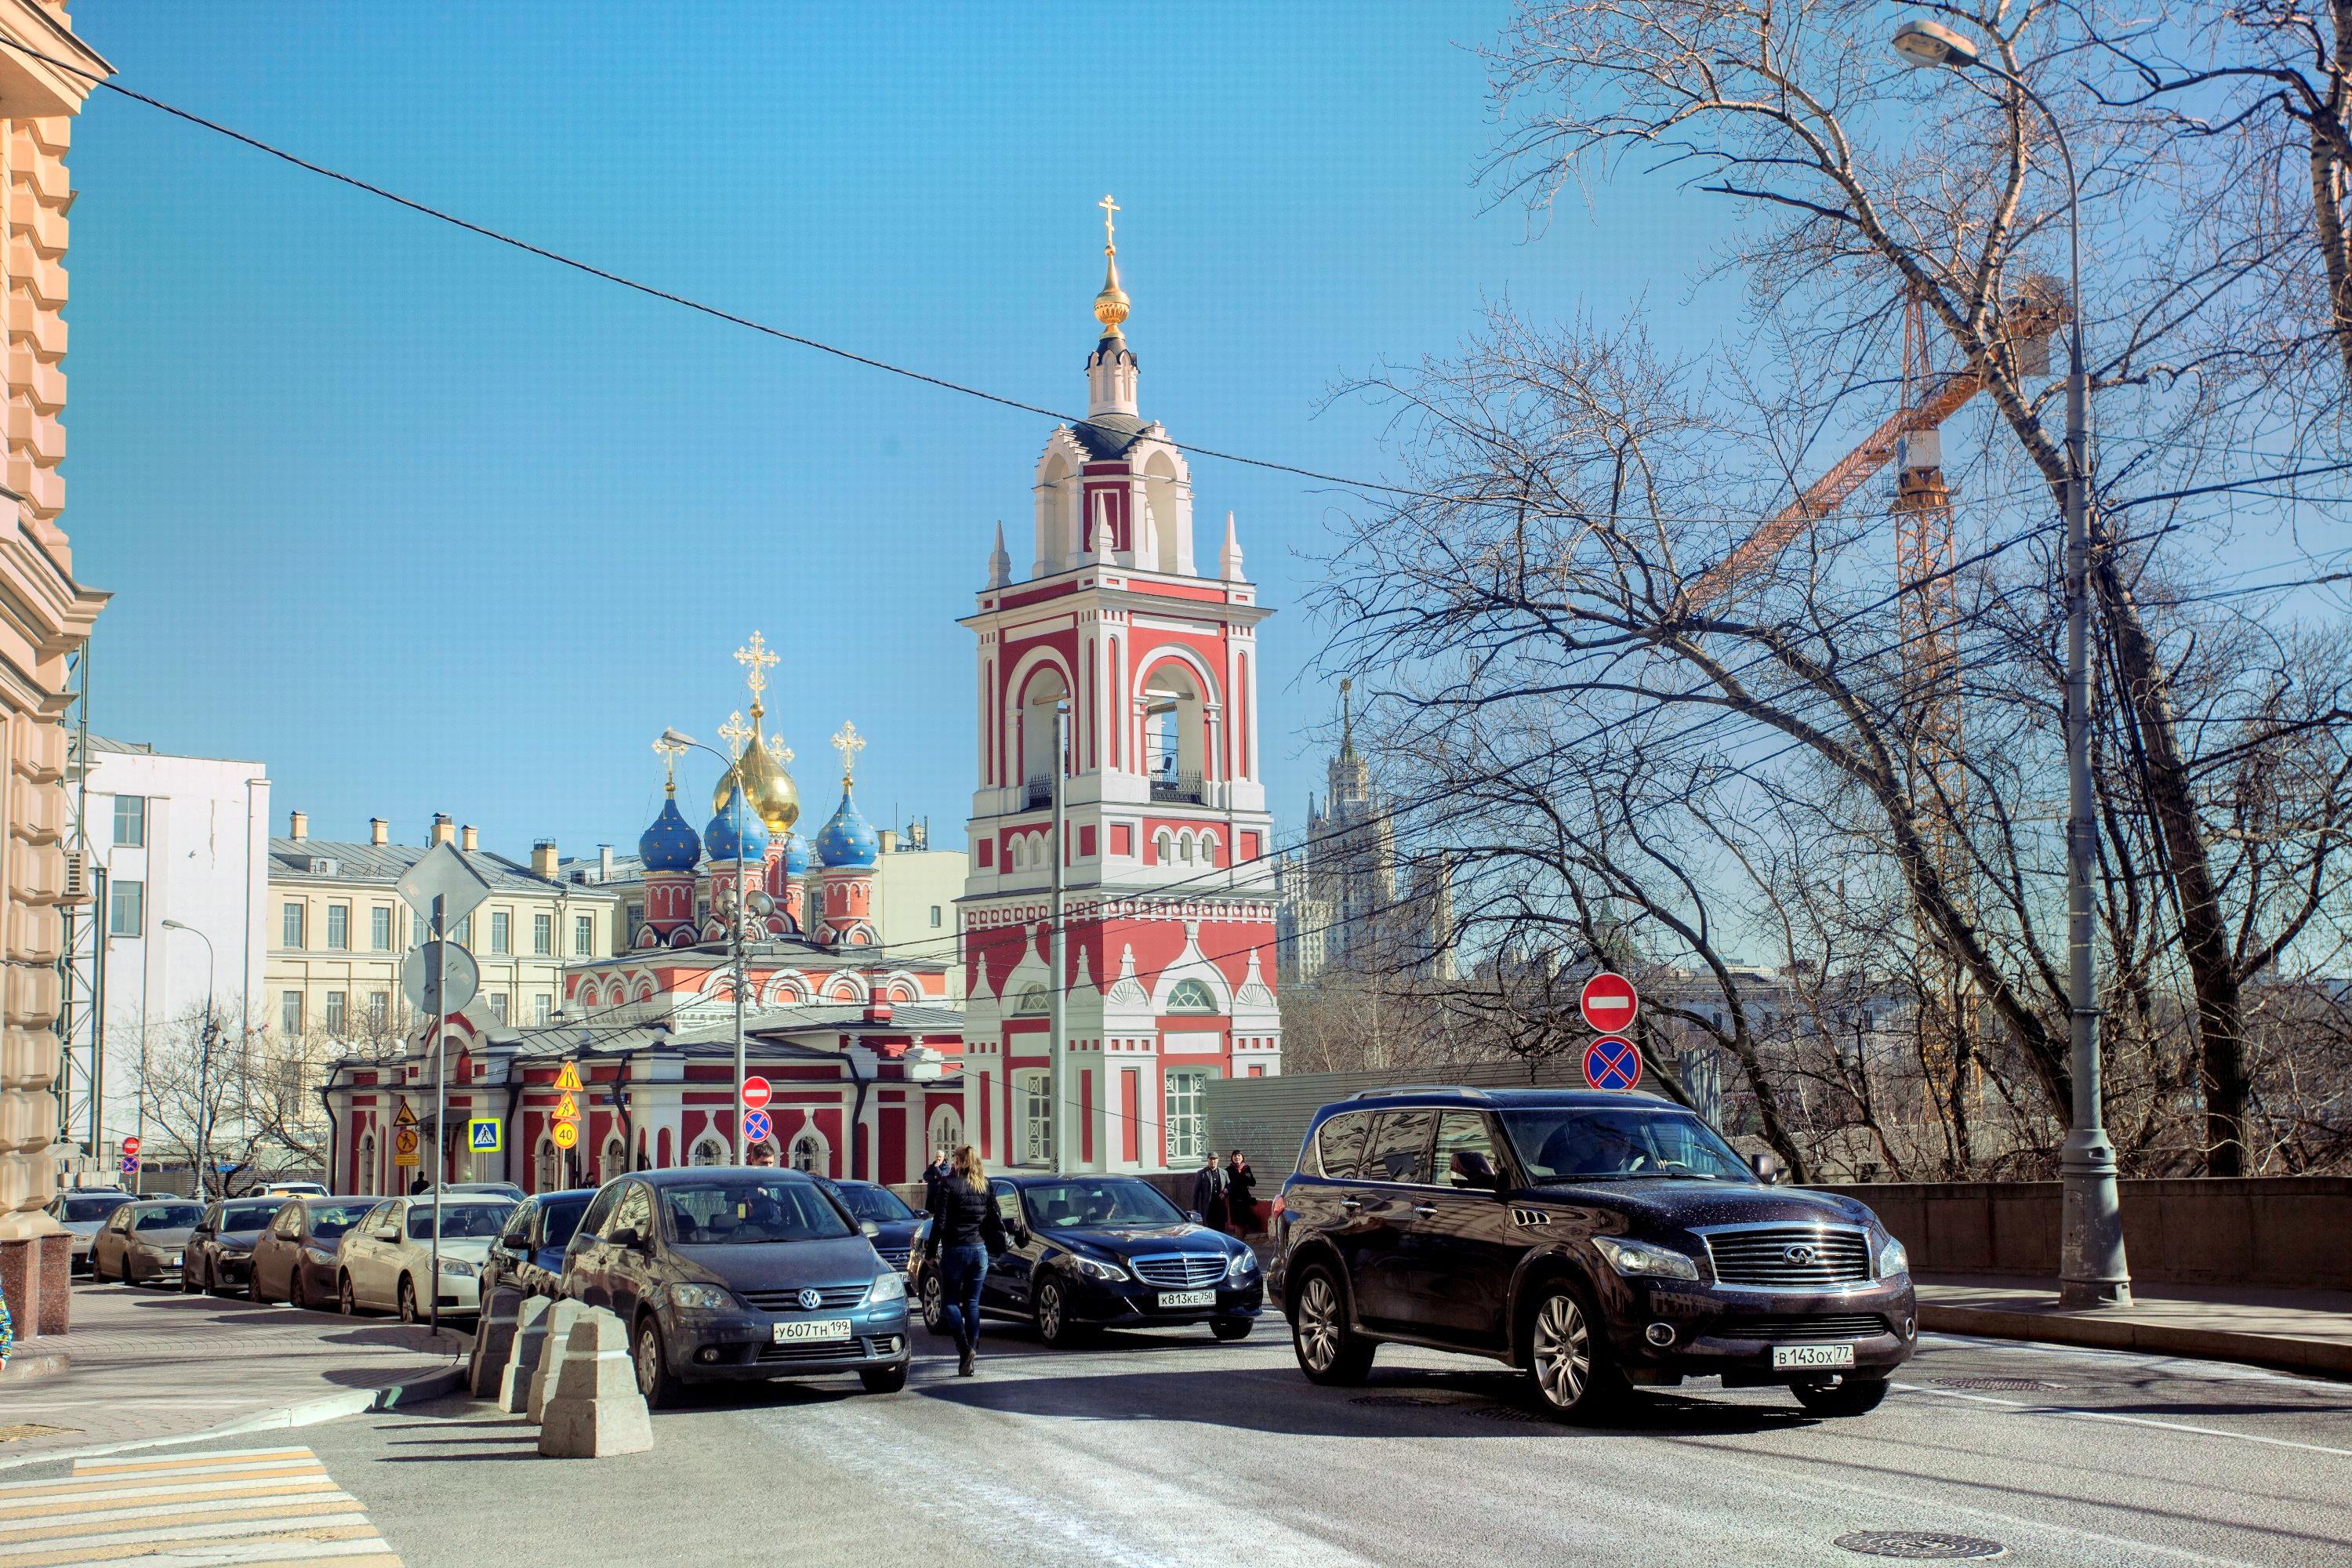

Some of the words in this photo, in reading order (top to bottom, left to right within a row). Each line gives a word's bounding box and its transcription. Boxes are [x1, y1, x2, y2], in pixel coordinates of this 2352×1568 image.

[559, 1130, 572, 1140] 40
[1162, 1294, 1199, 1305] К813КЕ
[779, 1323, 828, 1338] У607ТН
[829, 1321, 848, 1331] 199
[1779, 1348, 1833, 1364] В143ОХ
[1836, 1347, 1849, 1358] 77
